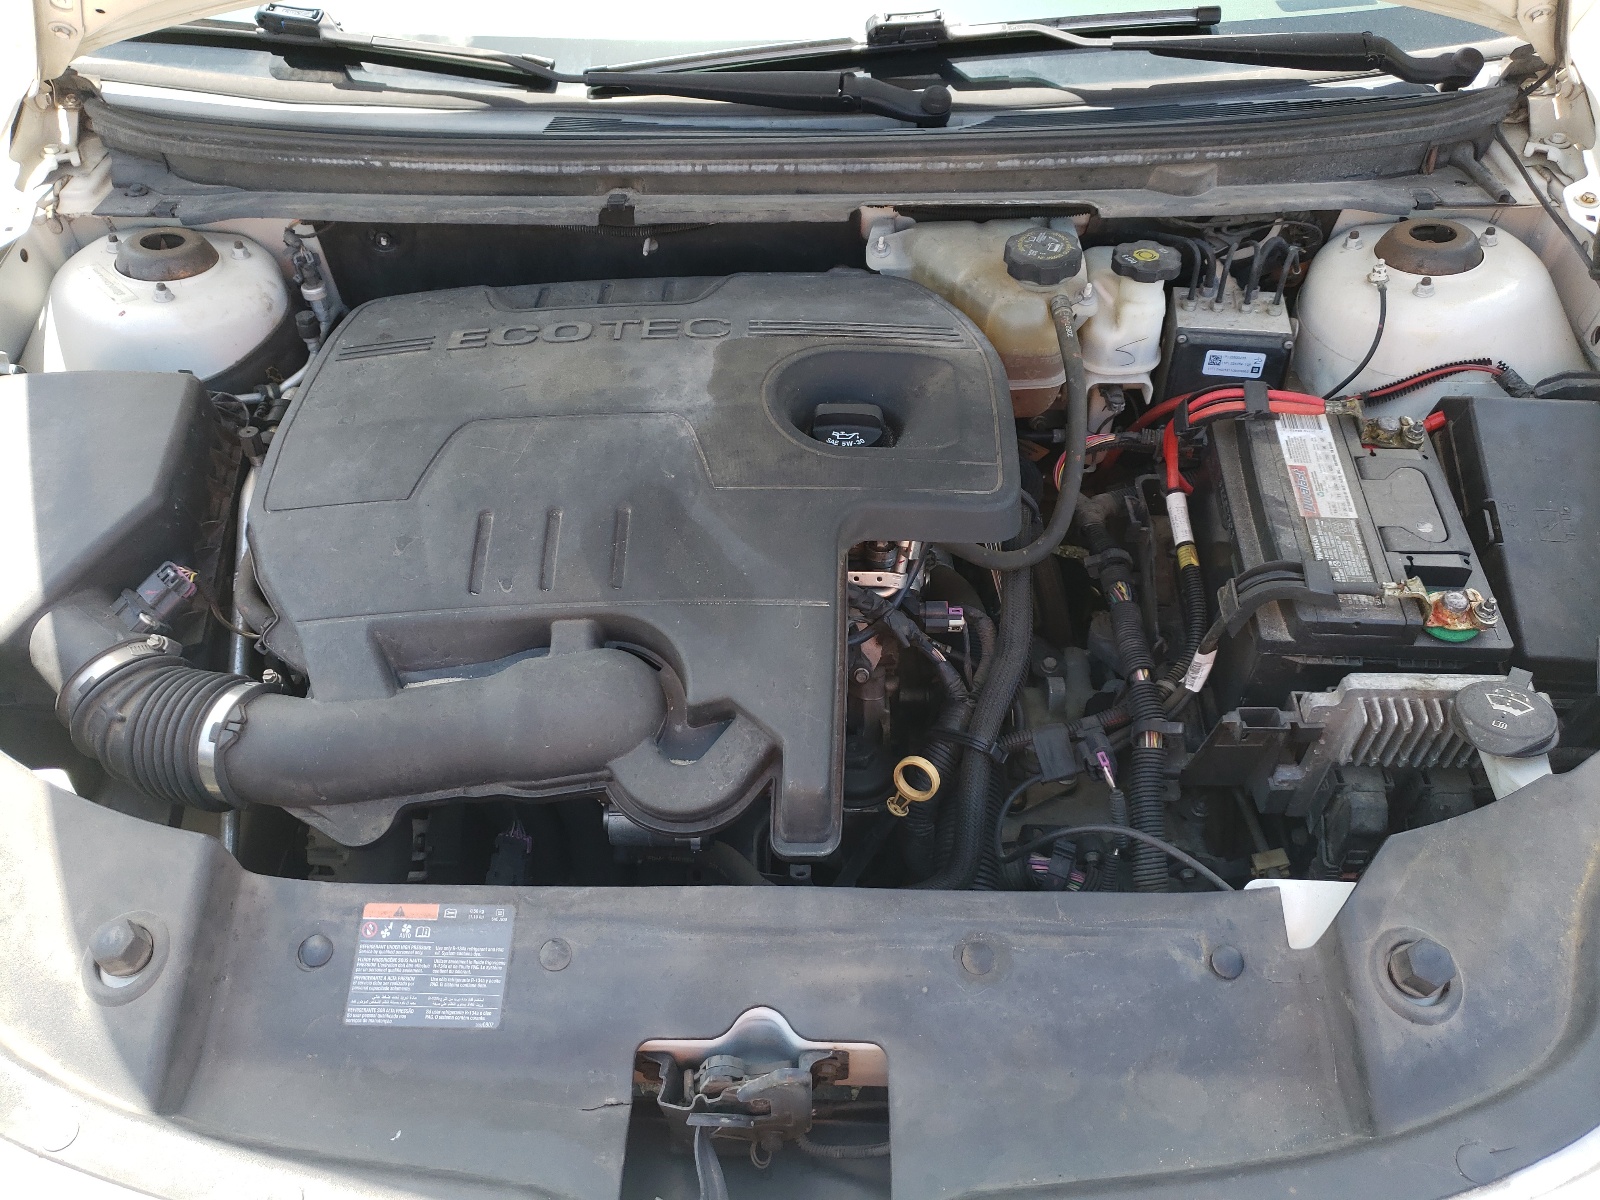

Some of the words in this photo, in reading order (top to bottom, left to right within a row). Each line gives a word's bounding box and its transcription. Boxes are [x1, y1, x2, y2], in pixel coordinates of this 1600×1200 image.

[446, 318, 731, 350] ECOTEC
[826, 438, 839, 446] SAE
[841, 438, 865, 447] 5W-30
[1292, 467, 1317, 514] Duralast
